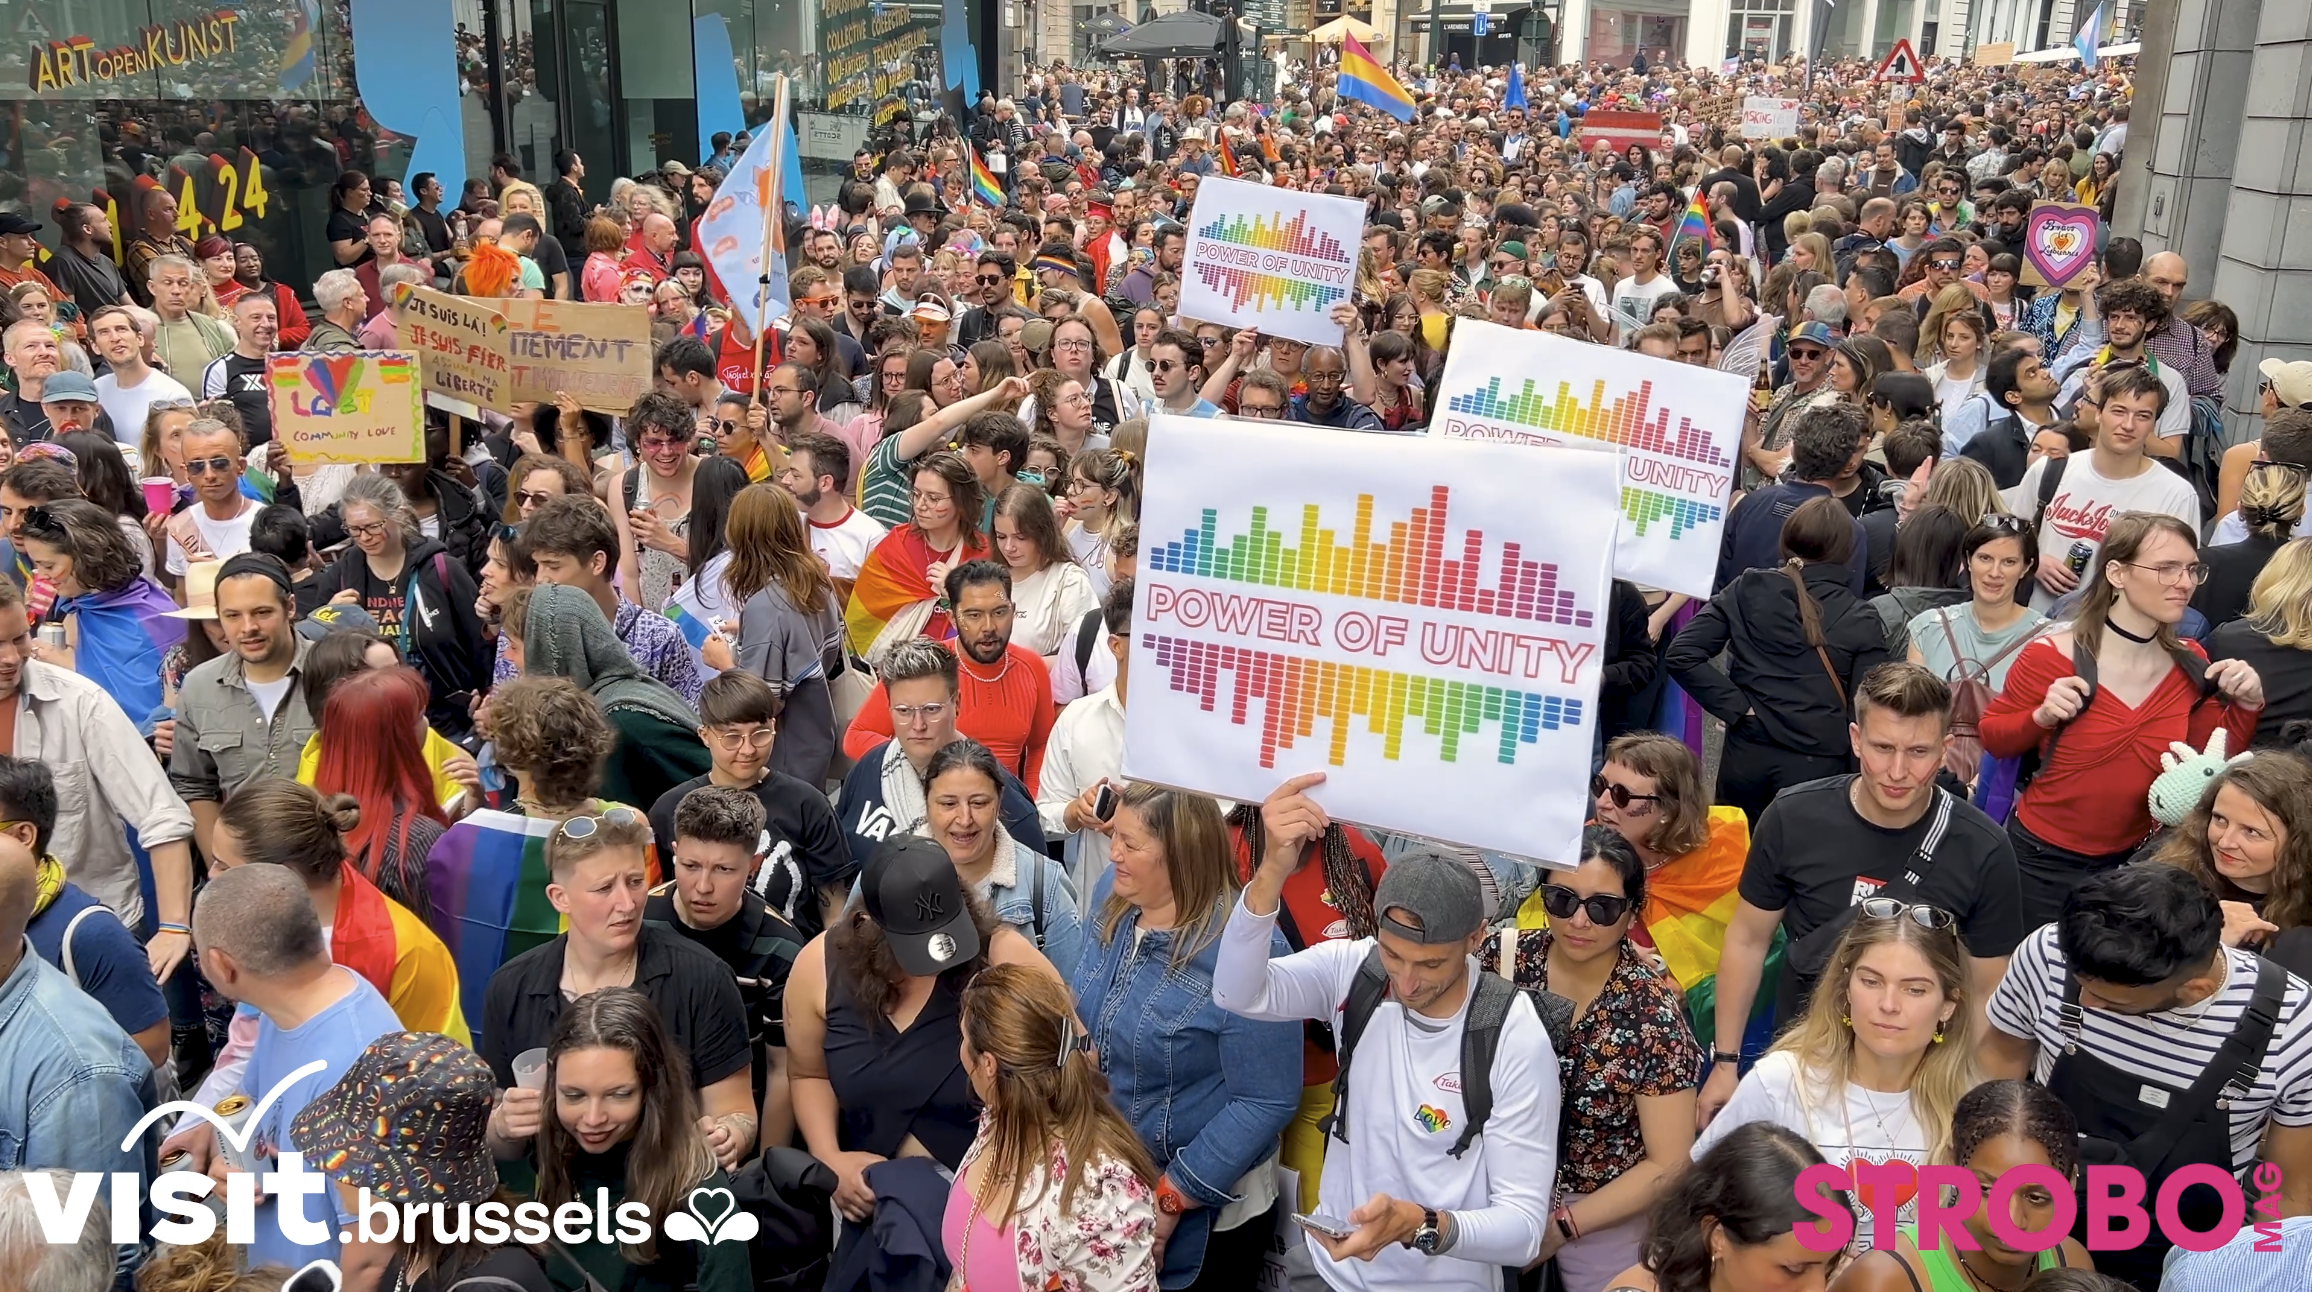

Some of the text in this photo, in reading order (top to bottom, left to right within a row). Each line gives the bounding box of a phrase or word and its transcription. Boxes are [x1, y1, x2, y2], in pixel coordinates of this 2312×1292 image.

[827, 19, 867, 53] COLLECTIVE
[33, 14, 238, 94] ART OPEN KUNST
[1743, 110, 1772, 125] ASKING
[1195, 242, 1350, 284] POWER OF UNITY
[409, 298, 426, 316] JE
[410, 323, 427, 346] JE
[293, 427, 396, 442] COMMUNITY LOVE
[1444, 419, 1563, 446] POWE
[1627, 456, 1729, 498] UNITY
[1146, 583, 1596, 684] POWER OF UNITY
[856, 800, 897, 842] VA
[1414, 1104, 1451, 1129] Love
